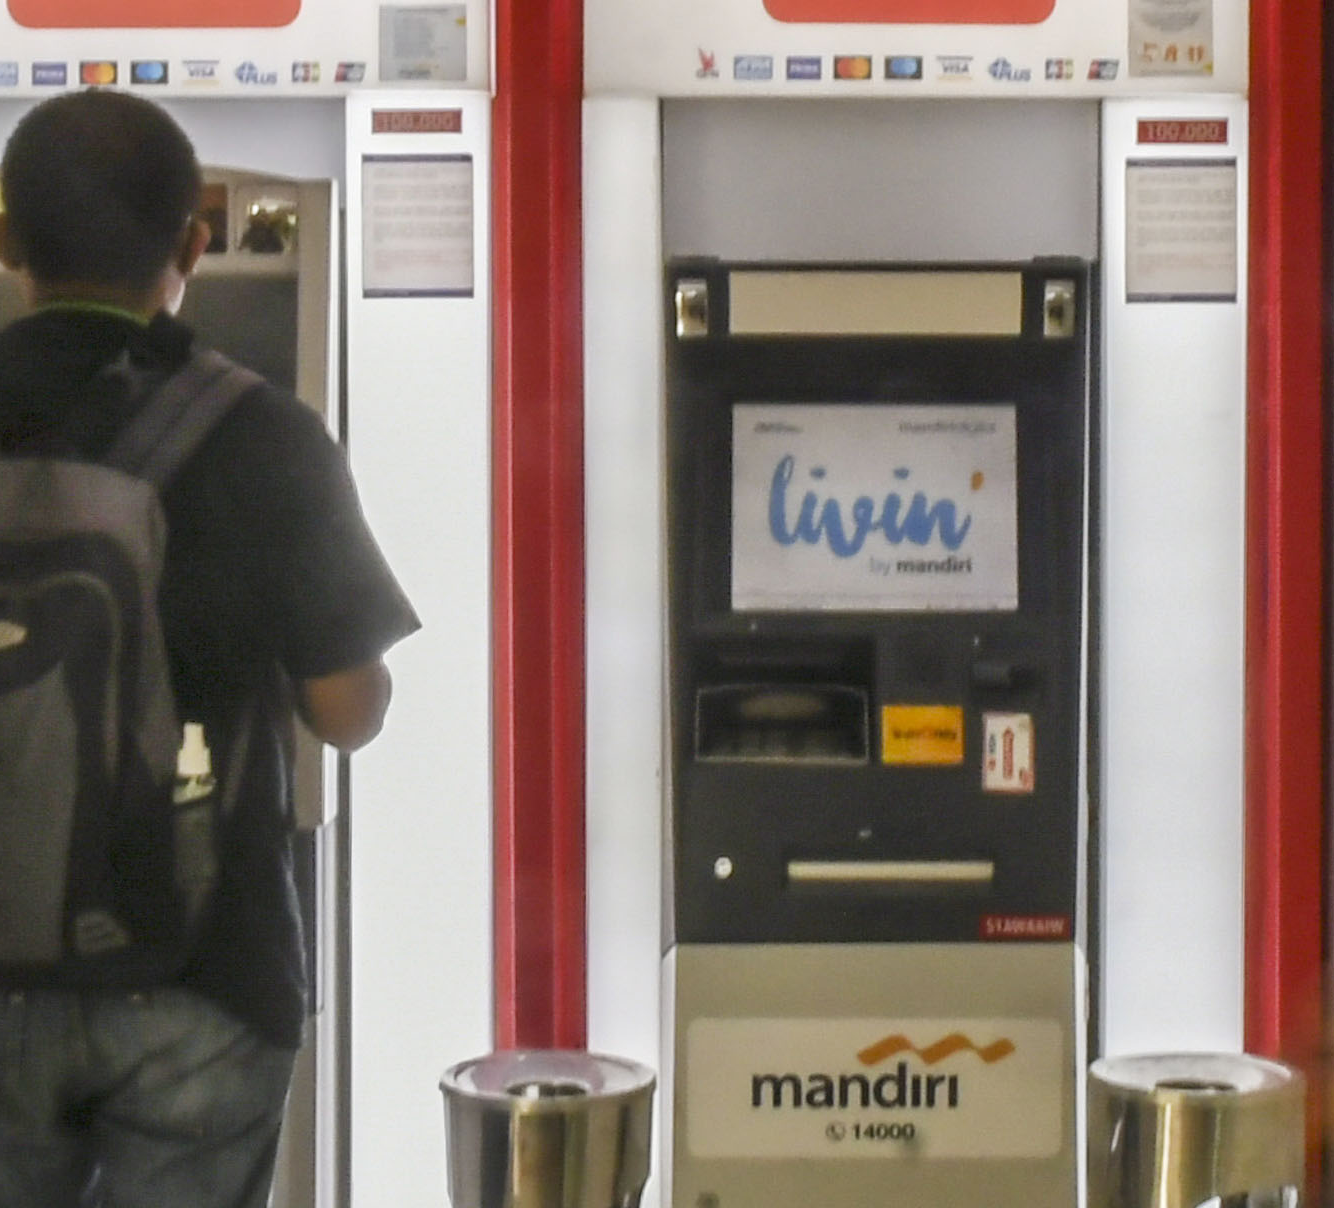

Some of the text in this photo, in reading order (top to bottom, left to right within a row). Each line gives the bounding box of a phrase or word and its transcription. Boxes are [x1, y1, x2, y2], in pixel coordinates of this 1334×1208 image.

[896, 556, 971, 574] mandiri
[751, 1062, 959, 1109] mandiri
[852, 1123, 915, 1141] 14000
